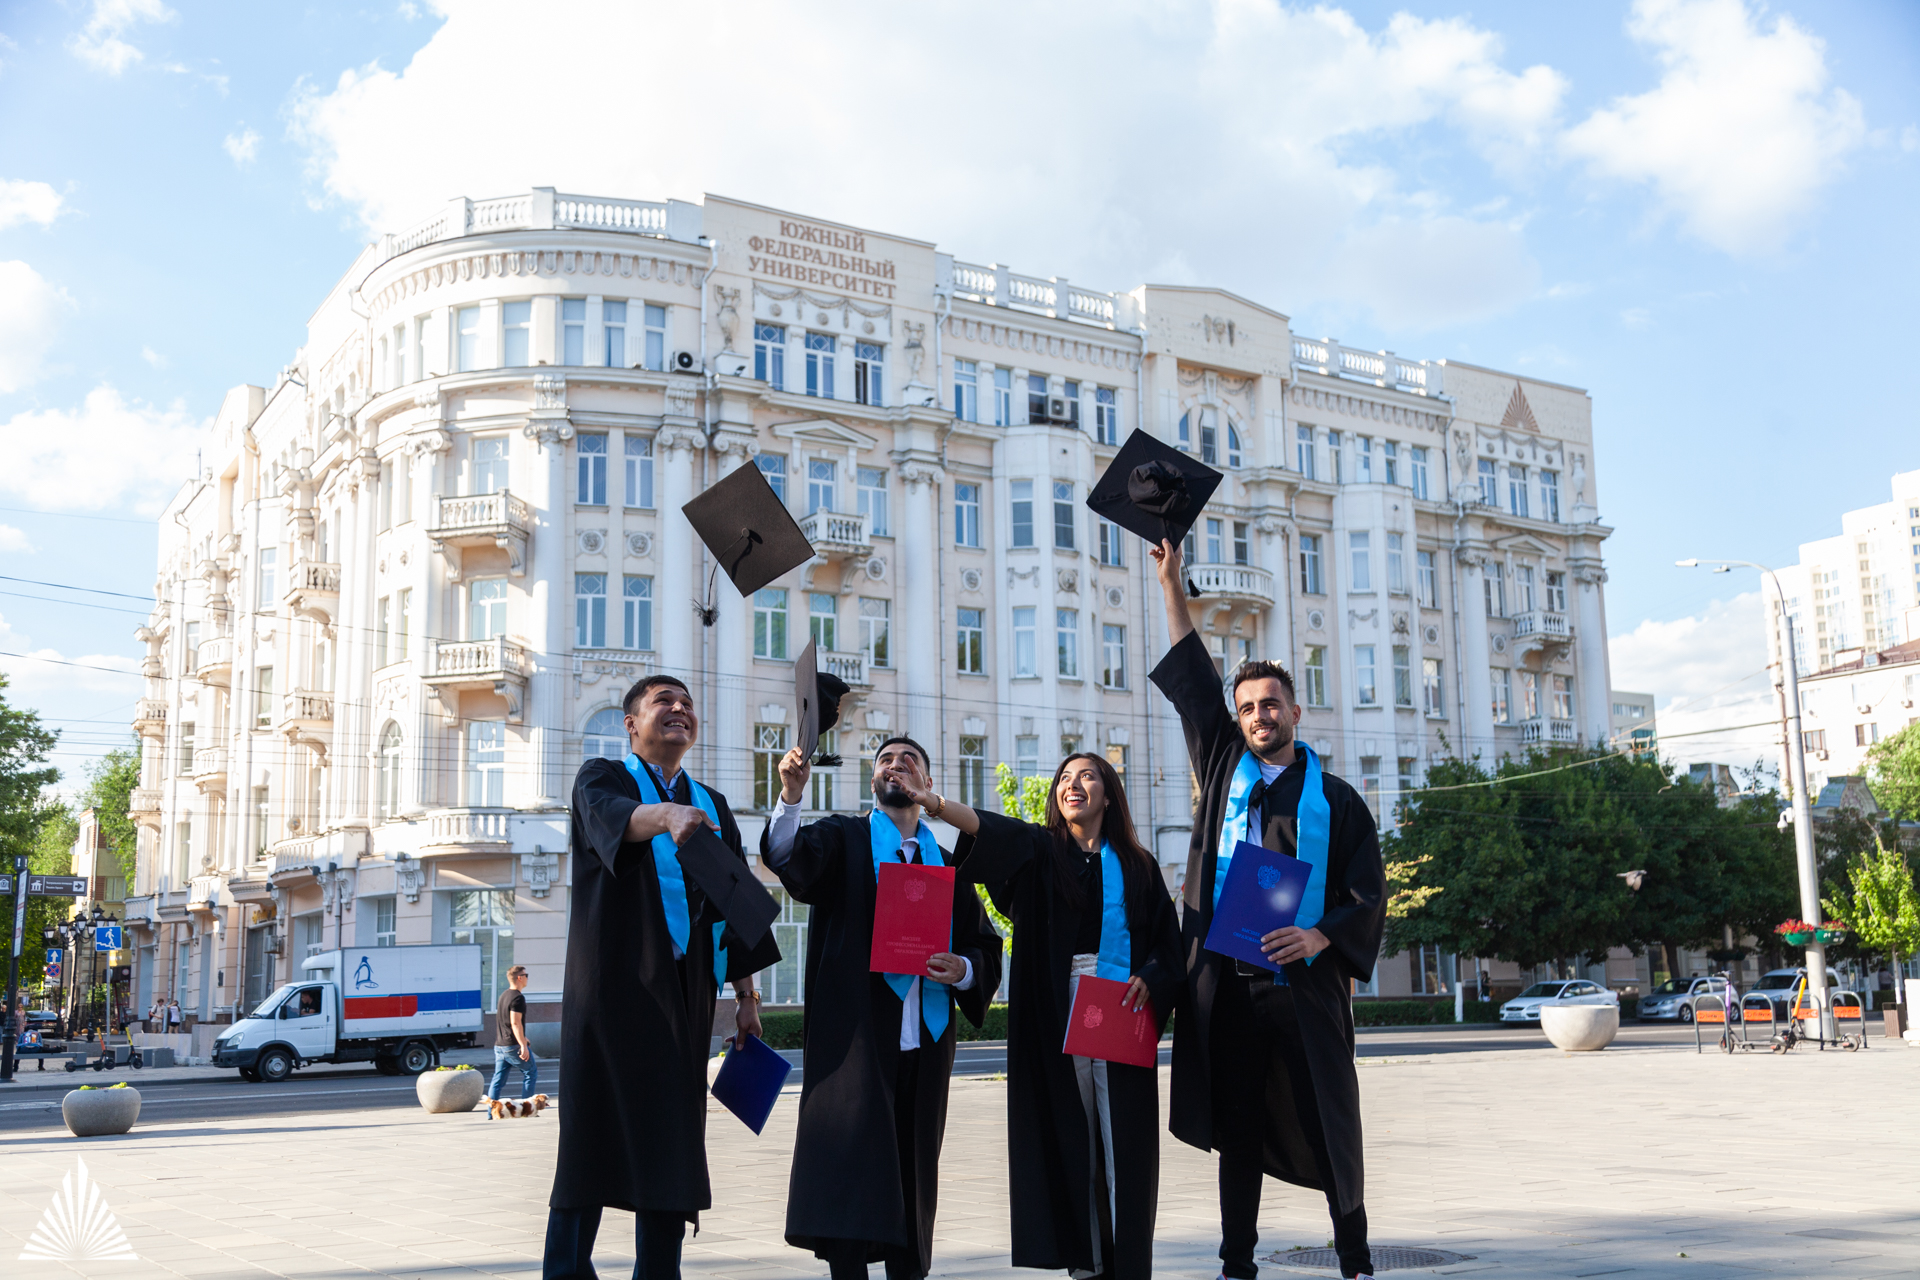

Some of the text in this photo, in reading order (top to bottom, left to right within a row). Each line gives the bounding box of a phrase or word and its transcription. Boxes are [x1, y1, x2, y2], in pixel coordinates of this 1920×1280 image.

[748, 236, 895, 279] ФЕДЕРАЛЬНЫЙ
[780, 220, 866, 253] ЮЖНЫЙ
[749, 256, 896, 299] УНИВЕРСИТЕТ
